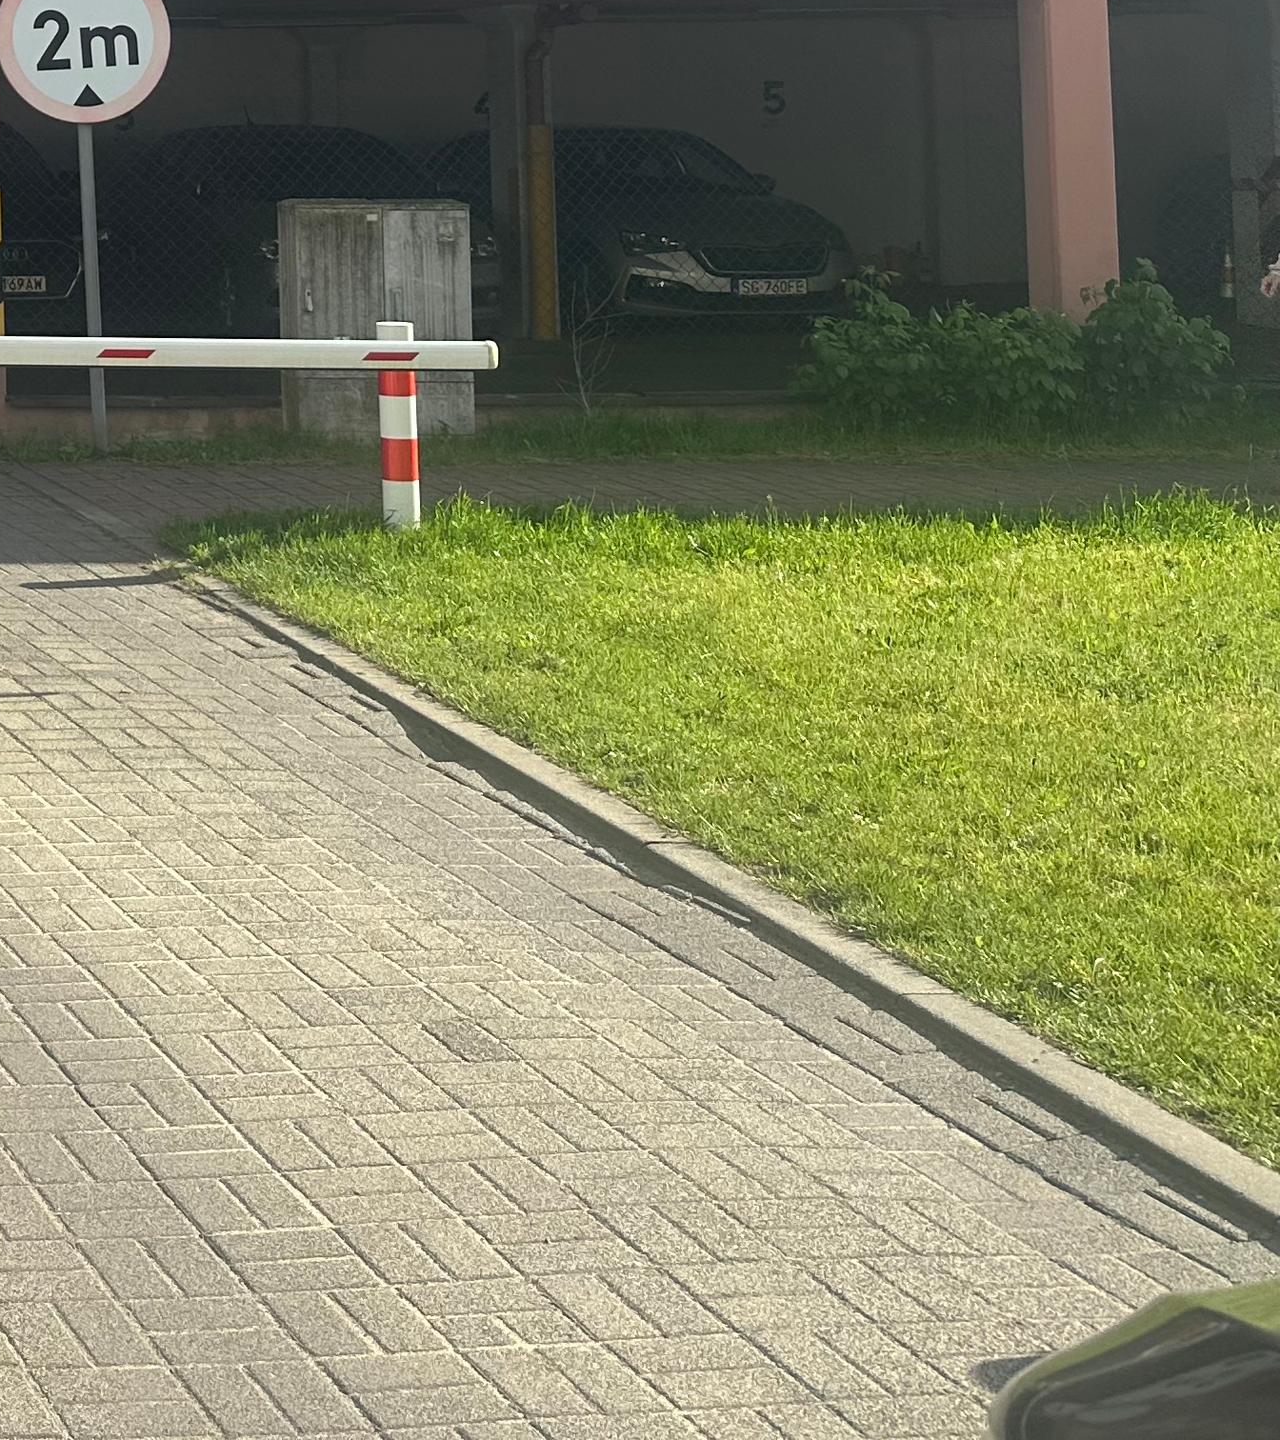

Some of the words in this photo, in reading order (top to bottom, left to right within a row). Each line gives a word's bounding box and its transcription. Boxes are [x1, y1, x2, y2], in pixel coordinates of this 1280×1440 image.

[33, 9, 139, 72] 2m
[763, 80, 786, 115] 5
[742, 280, 760, 293] SG
[763, 280, 805, 293] 760FE
